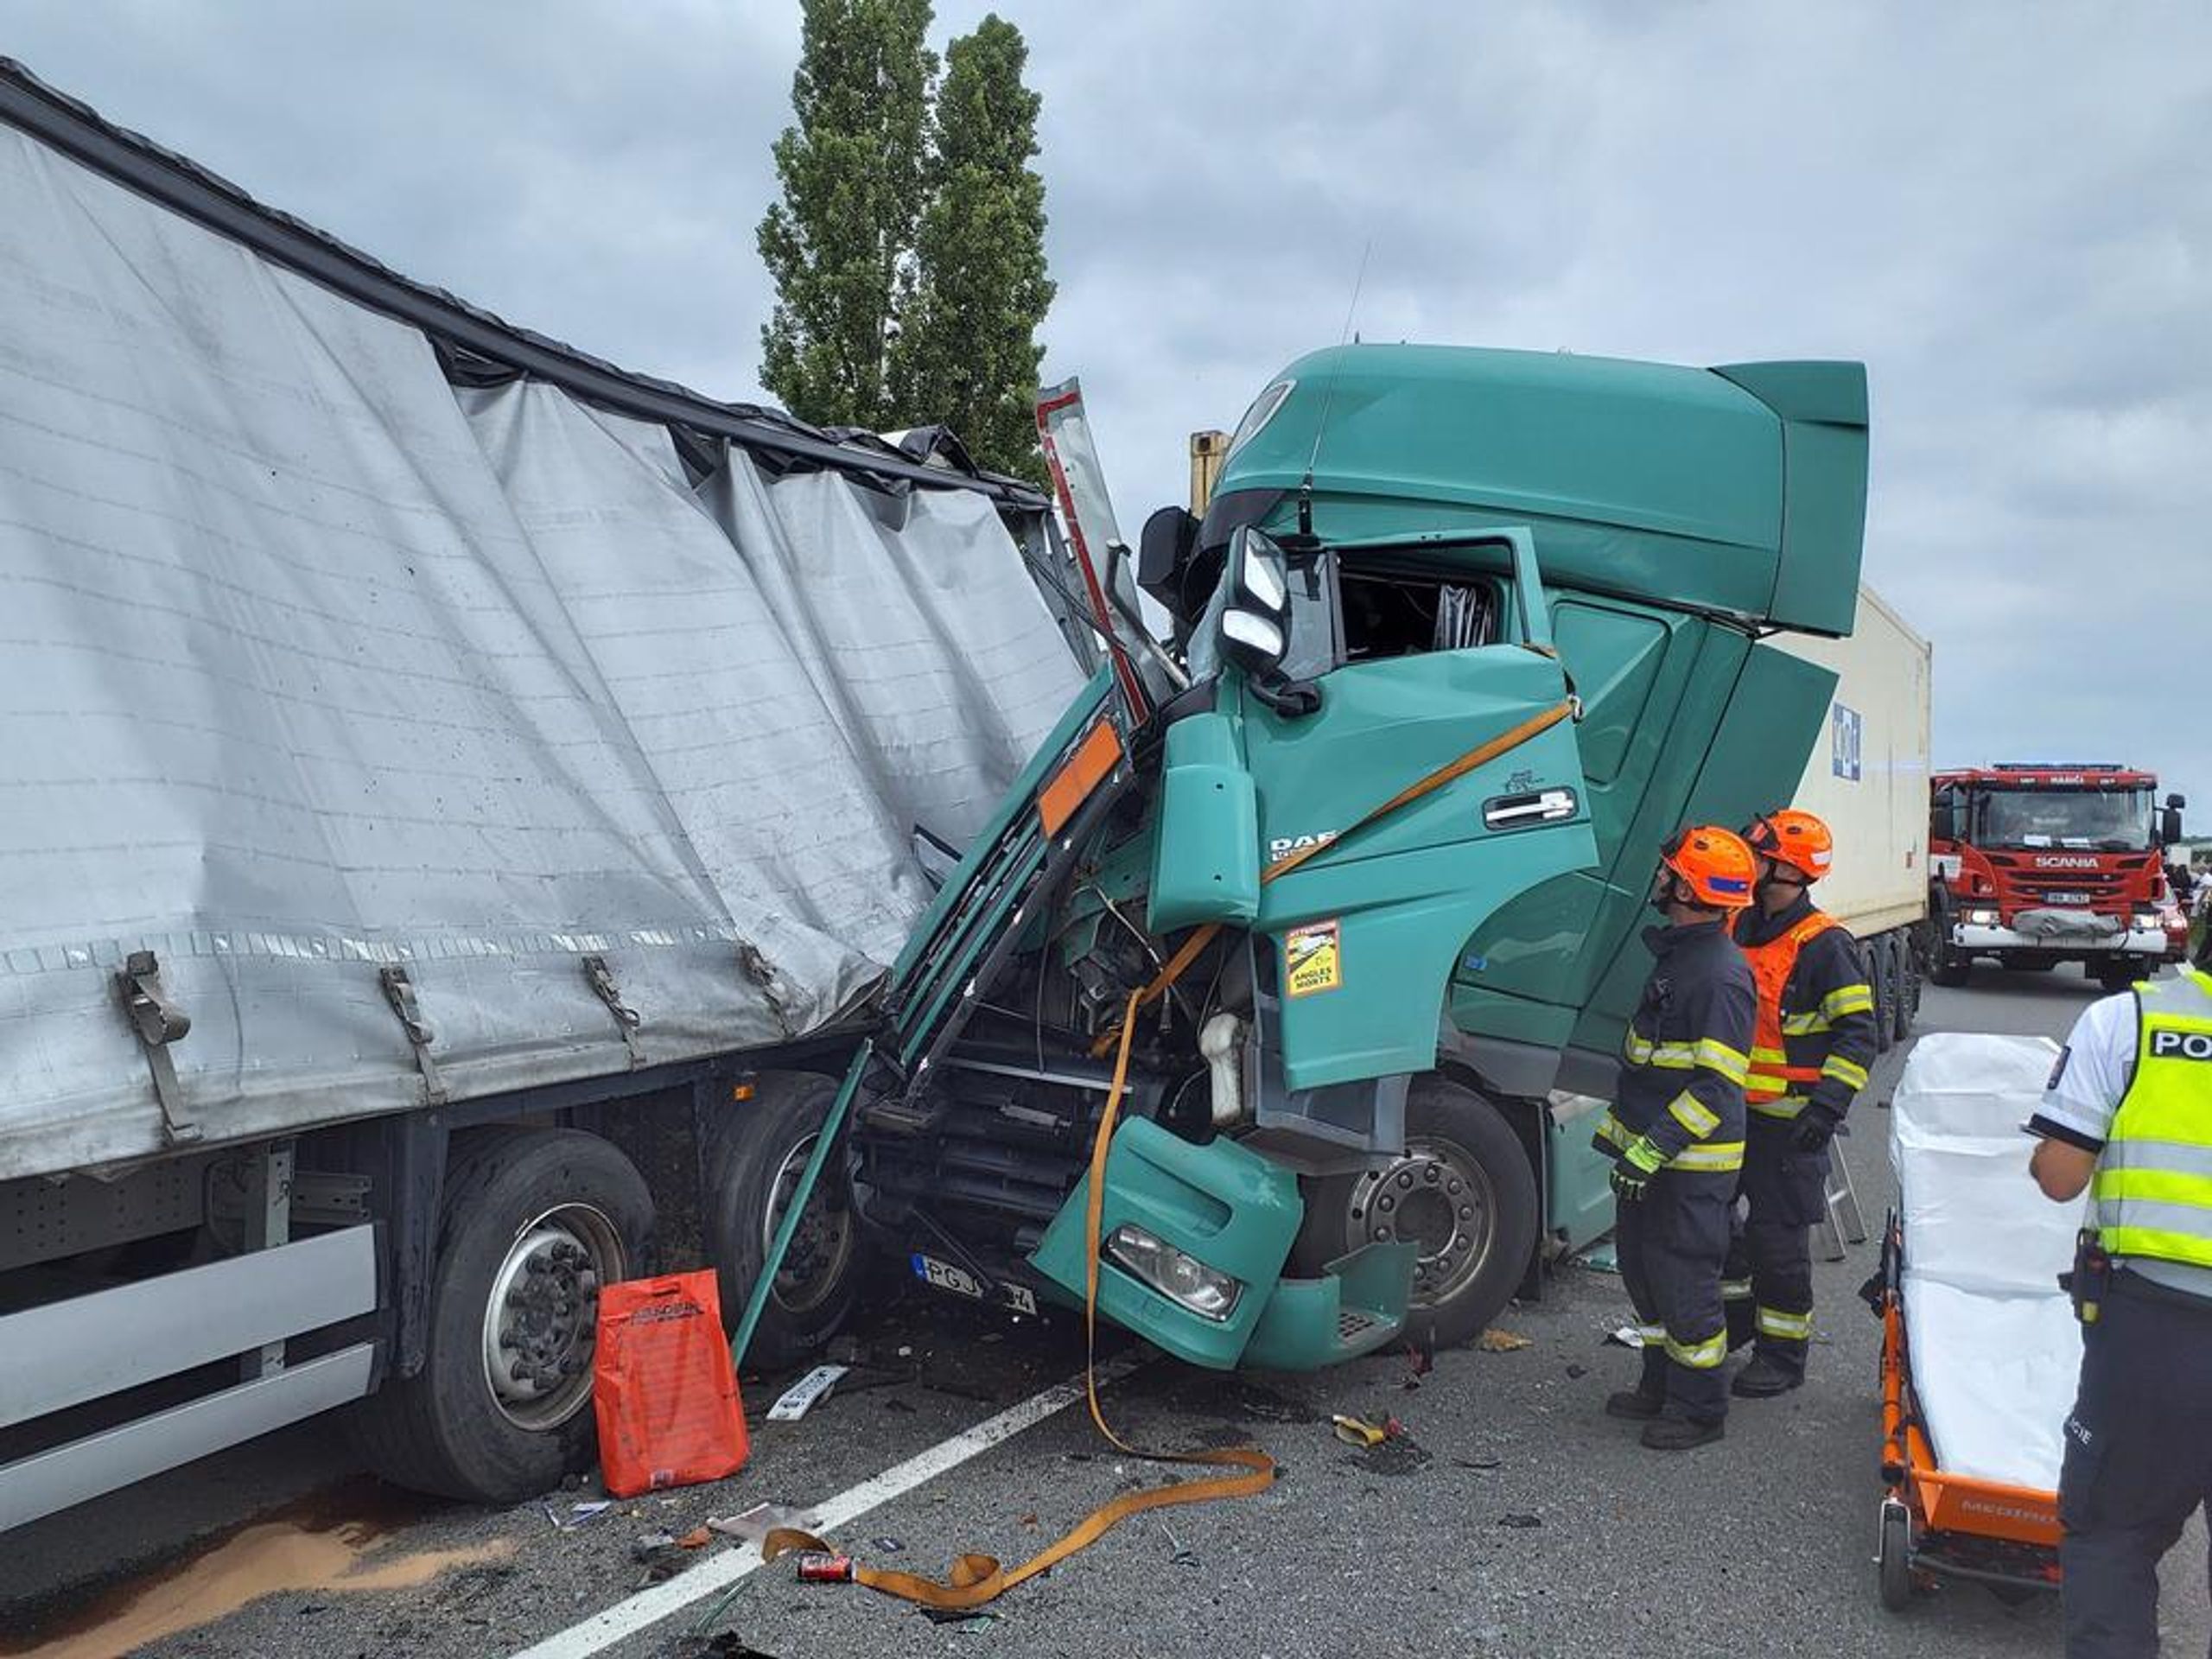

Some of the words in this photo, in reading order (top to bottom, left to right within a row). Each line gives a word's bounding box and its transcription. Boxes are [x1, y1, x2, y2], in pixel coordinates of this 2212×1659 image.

[2035, 857, 2099, 868] SCANIA
[1294, 967, 1332, 982] ANGLES
[1296, 976, 1332, 989] MORTS
